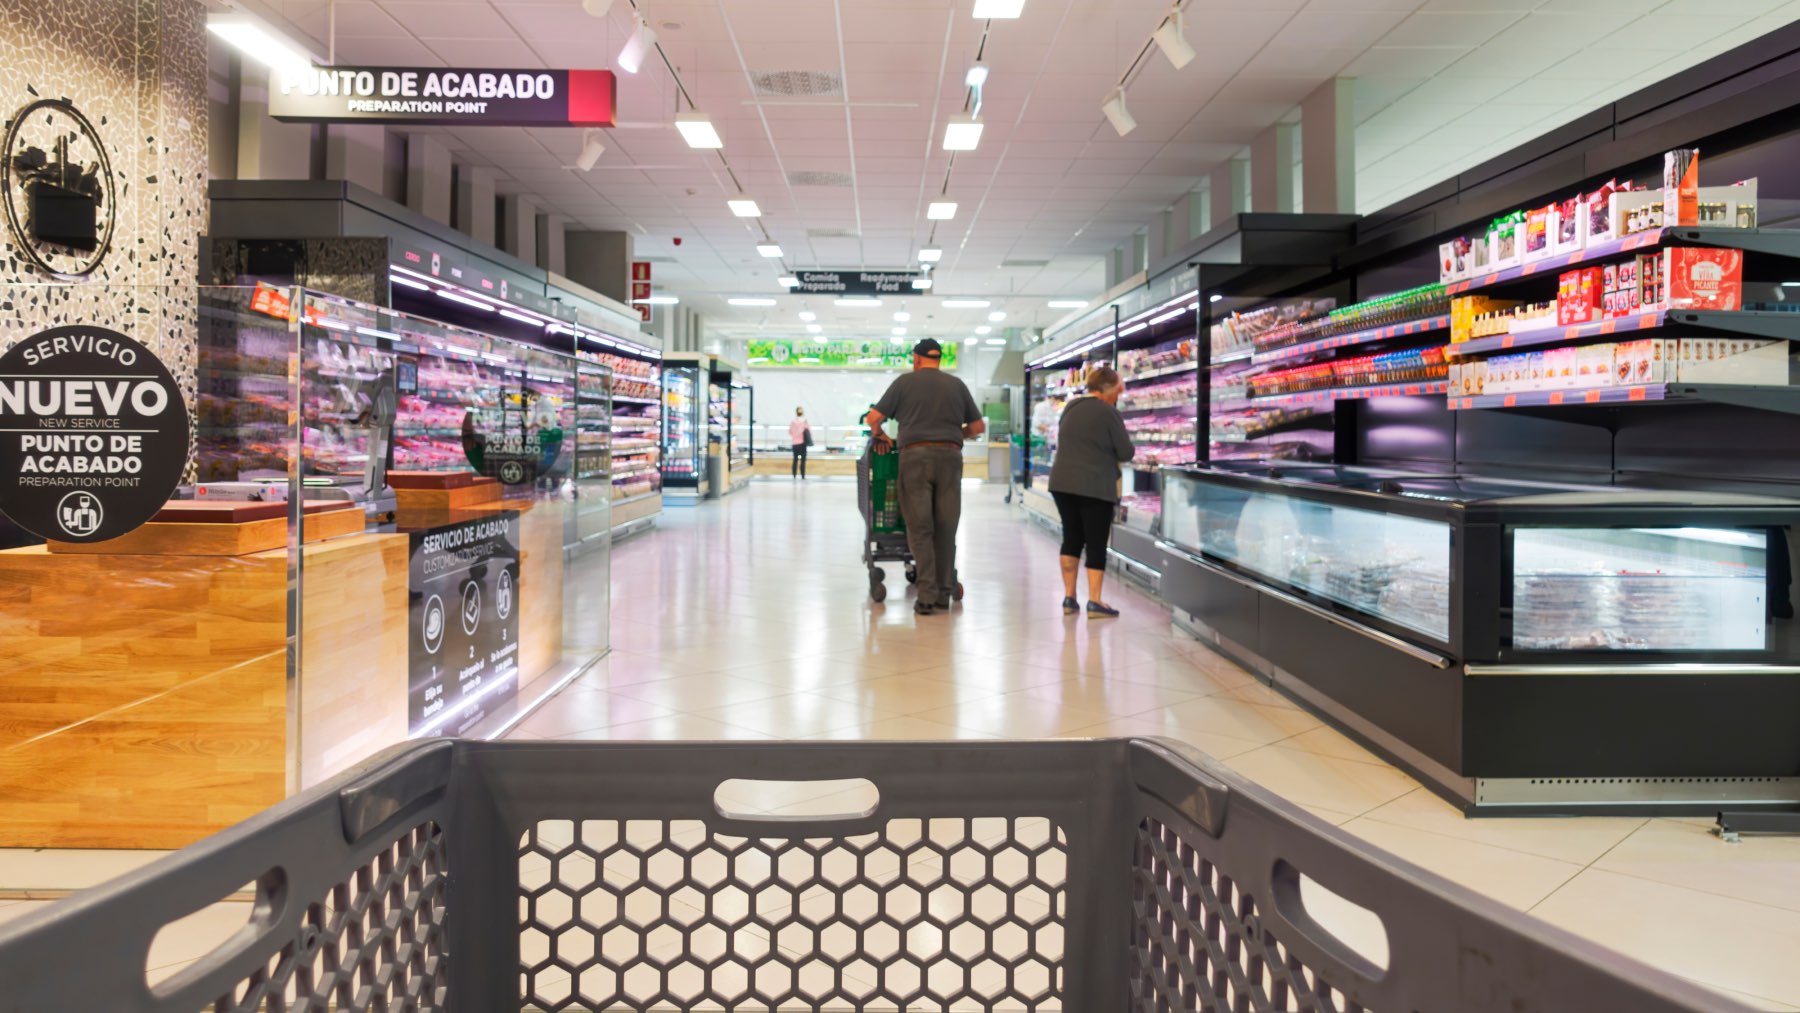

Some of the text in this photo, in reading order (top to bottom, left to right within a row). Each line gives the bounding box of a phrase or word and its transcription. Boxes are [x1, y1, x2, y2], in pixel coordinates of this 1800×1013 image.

[381, 71, 418, 98] DE
[423, 73, 555, 100] ACABADO
[348, 100, 488, 114] PREPARATION POINT
[803, 272, 839, 282] Comida
[876, 282, 899, 291] Food
[23, 335, 136, 366] SERVICIO
[0, 380, 168, 417] NUEVO
[39, 418, 121, 429] NEW SERVICE
[21, 435, 142, 453] PUNTO DE
[526, 436, 541, 445] DE
[484, 445, 541, 454] ACABADO
[20, 455, 142, 474] ACABADO
[19, 477, 141, 487] PREPARATION POINT
[423, 519, 509, 555] SERVICIO DE ACABADO
[471, 542, 494, 560] SERVICE
[502, 628, 507, 641] 3
[469, 645, 475, 659] 2
[432, 666, 437, 680] 1
